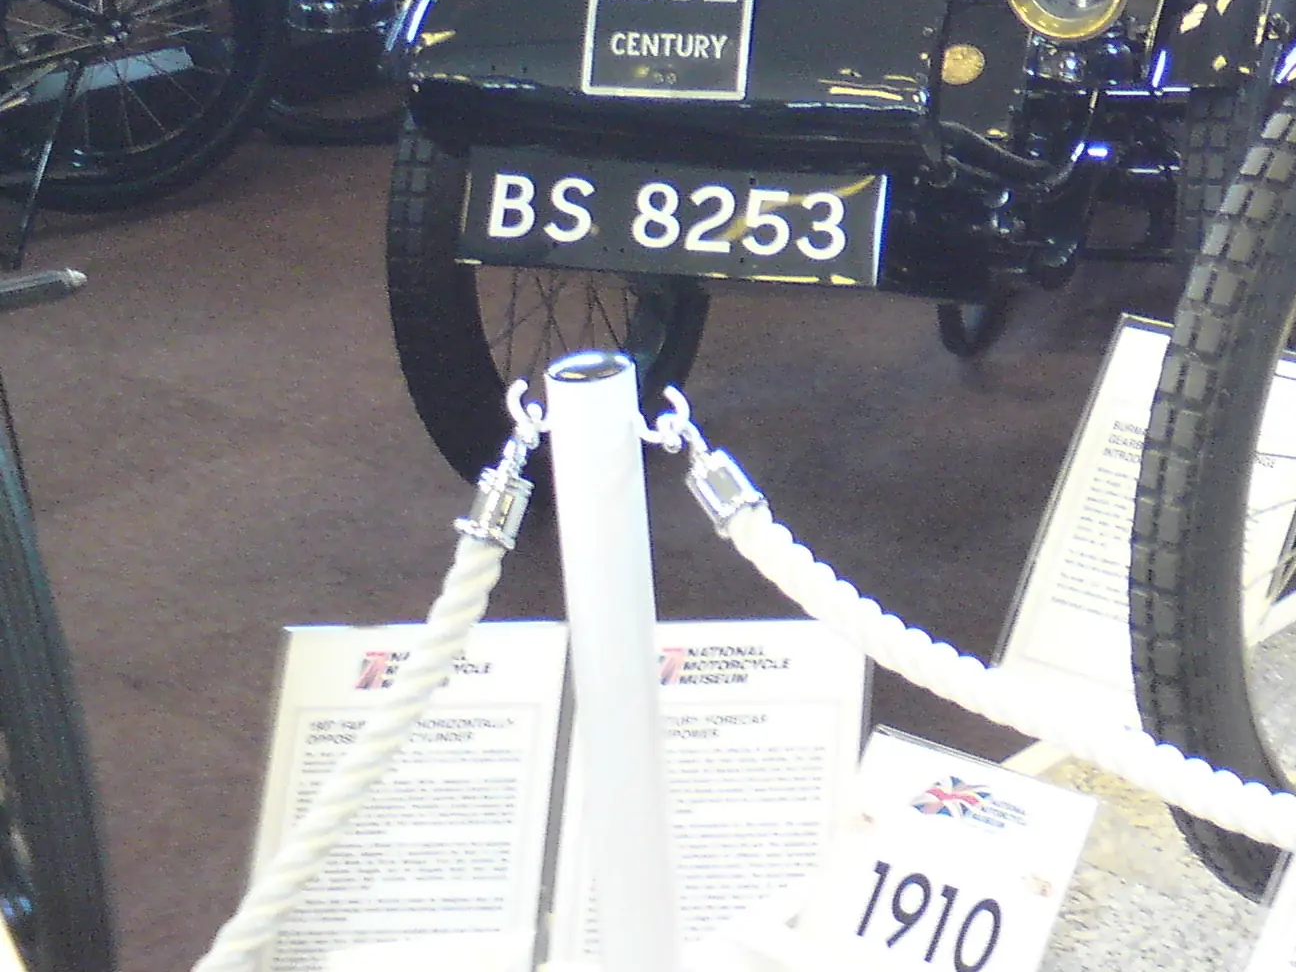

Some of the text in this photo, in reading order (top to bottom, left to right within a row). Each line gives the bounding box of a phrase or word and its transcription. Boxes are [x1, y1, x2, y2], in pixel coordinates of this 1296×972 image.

[611, 31, 728, 59] CENTURY
[488, 173, 846, 260] BS 8253
[687, 646, 765, 657] NATIONAL
[683, 658, 792, 670] MOTORCYCLE
[678, 673, 749, 685] MUSEUM
[857, 860, 1001, 972] 1910
